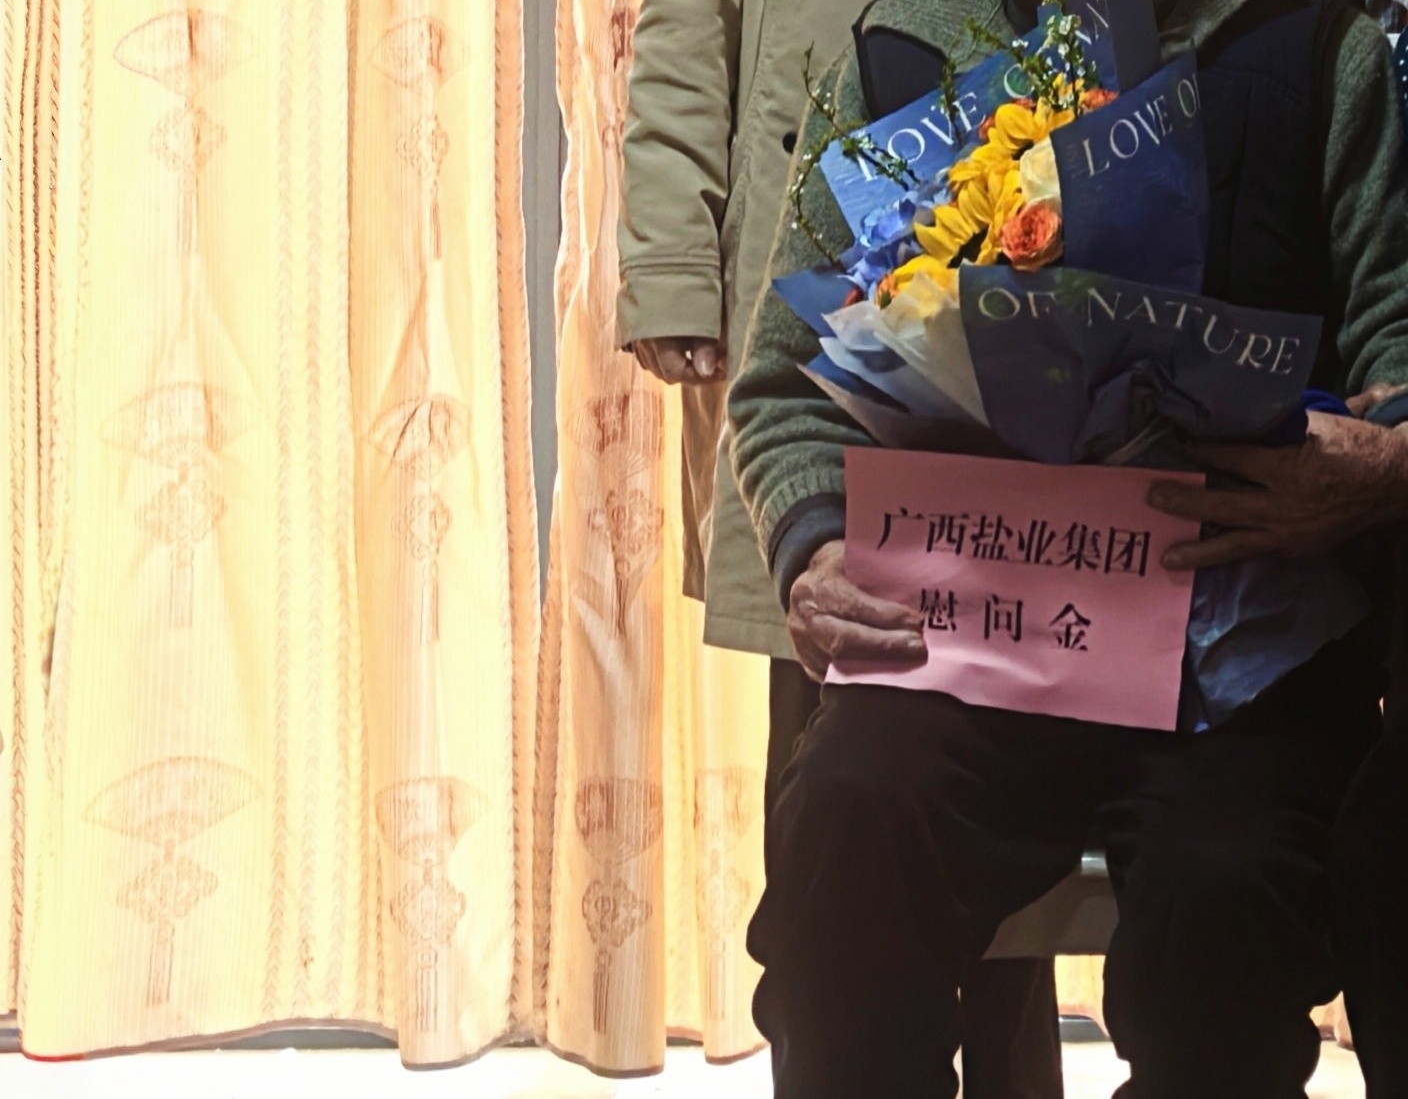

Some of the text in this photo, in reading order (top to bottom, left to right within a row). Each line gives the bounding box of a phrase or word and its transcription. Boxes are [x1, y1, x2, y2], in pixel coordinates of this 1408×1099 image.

[1082, 95, 1173, 177] LOVE
[978, 287, 1300, 375] OF NATURE
[876, 507, 1151, 577] 广西盐业集团
[919, 588, 1092, 652] 慰问金
